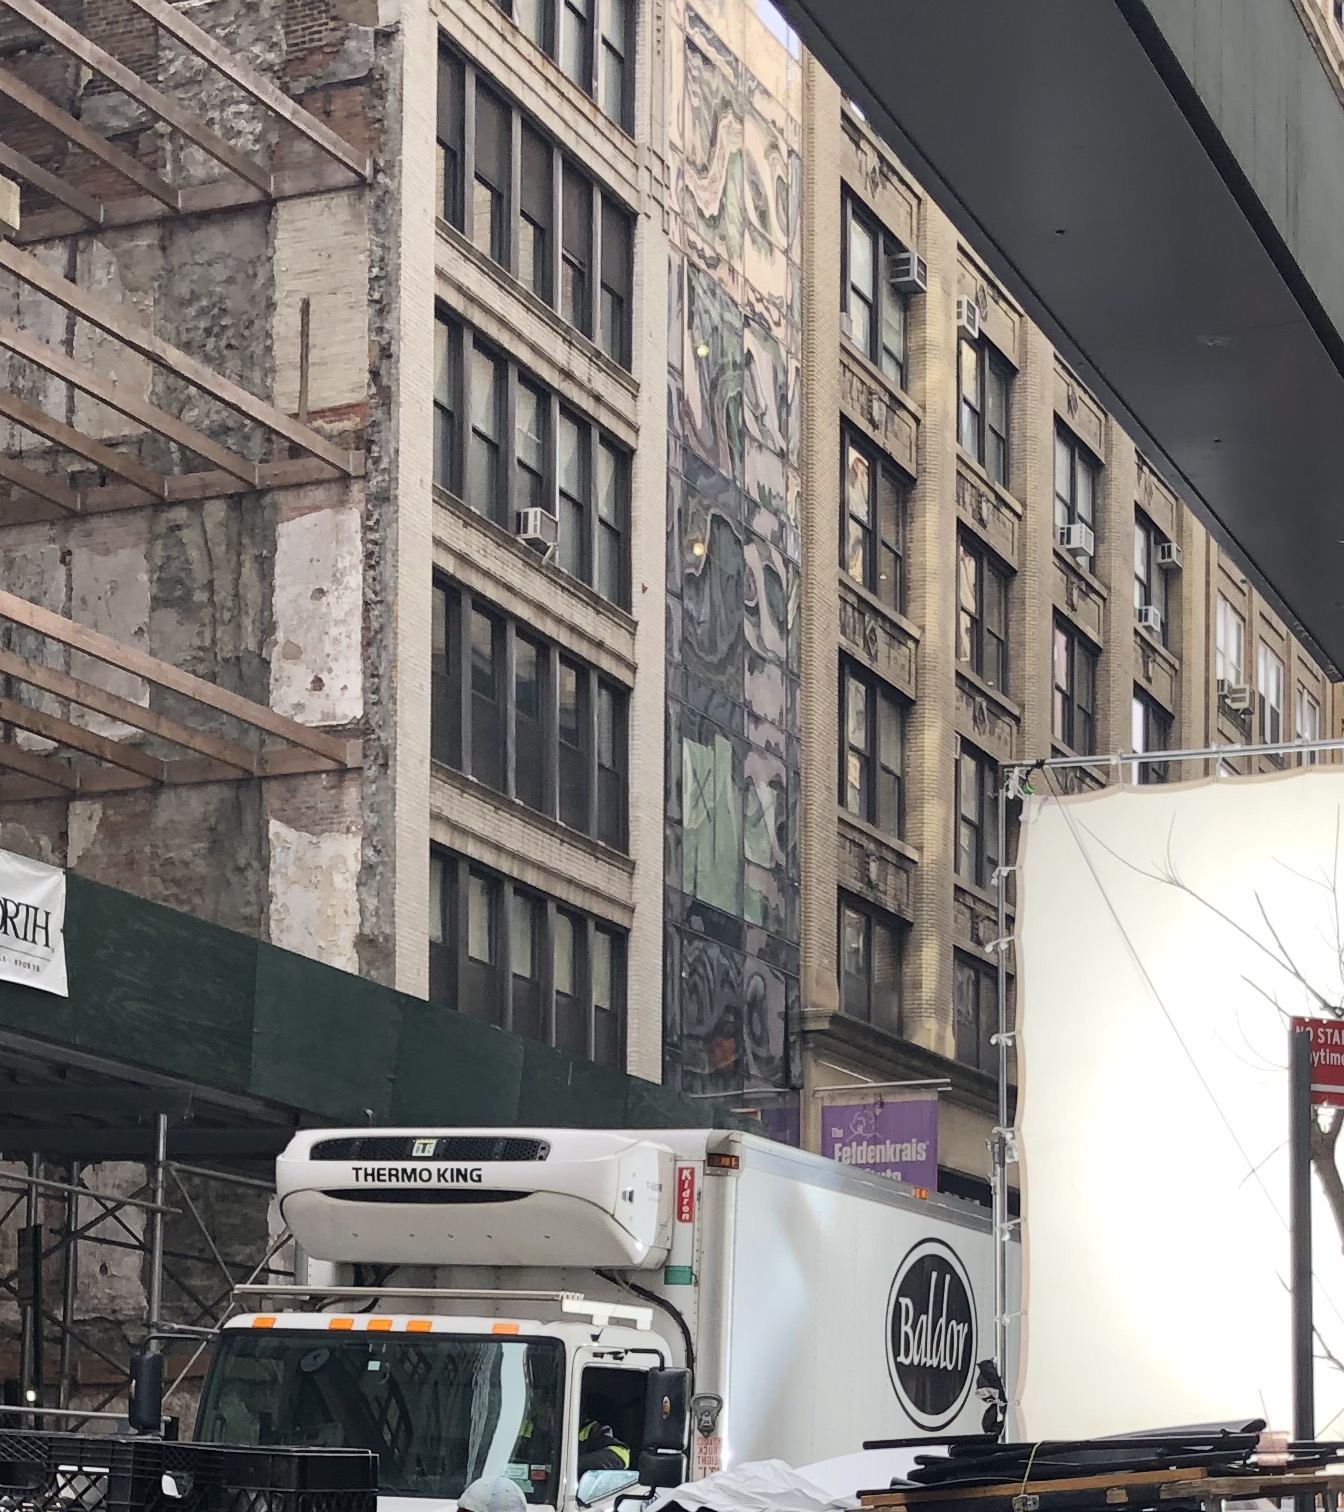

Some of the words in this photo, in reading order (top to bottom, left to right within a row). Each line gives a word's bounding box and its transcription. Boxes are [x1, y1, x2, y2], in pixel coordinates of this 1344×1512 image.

[14, 958, 41, 973] SPORTS
[834, 1138, 927, 1165] Feldenkrais
[352, 1166, 433, 1183] THERMO
[437, 1167, 483, 1183] KING
[896, 1270, 969, 1371] Baldor
